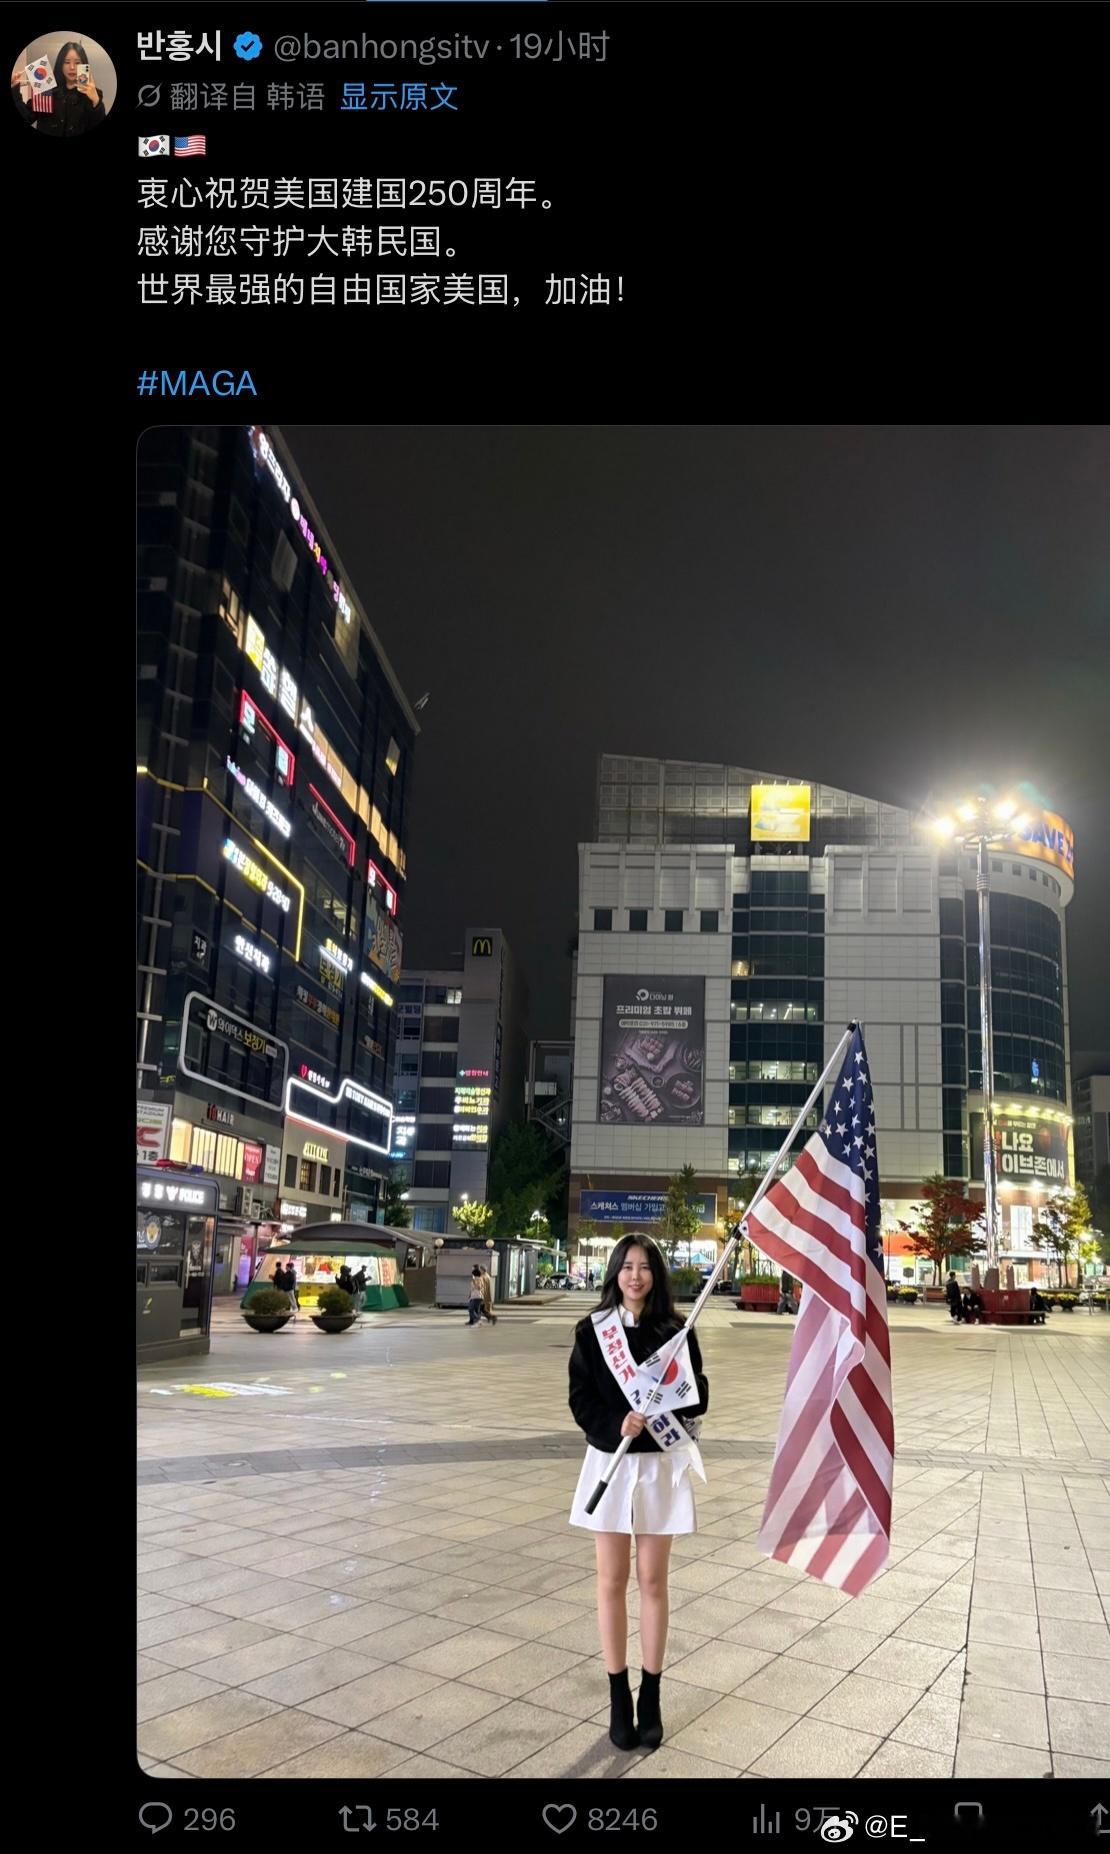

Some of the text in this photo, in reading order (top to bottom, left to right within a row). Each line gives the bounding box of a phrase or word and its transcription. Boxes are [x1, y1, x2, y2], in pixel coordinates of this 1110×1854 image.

[616, 1005, 692, 1016] 프리미엄 초밥 뷔페
[1002, 1131, 1033, 1152] 나요
[1002, 1153, 1065, 1179] 이브존에서
[645, 1202, 665, 1212] 가입고
[602, 1325, 636, 1385] 부정선거
